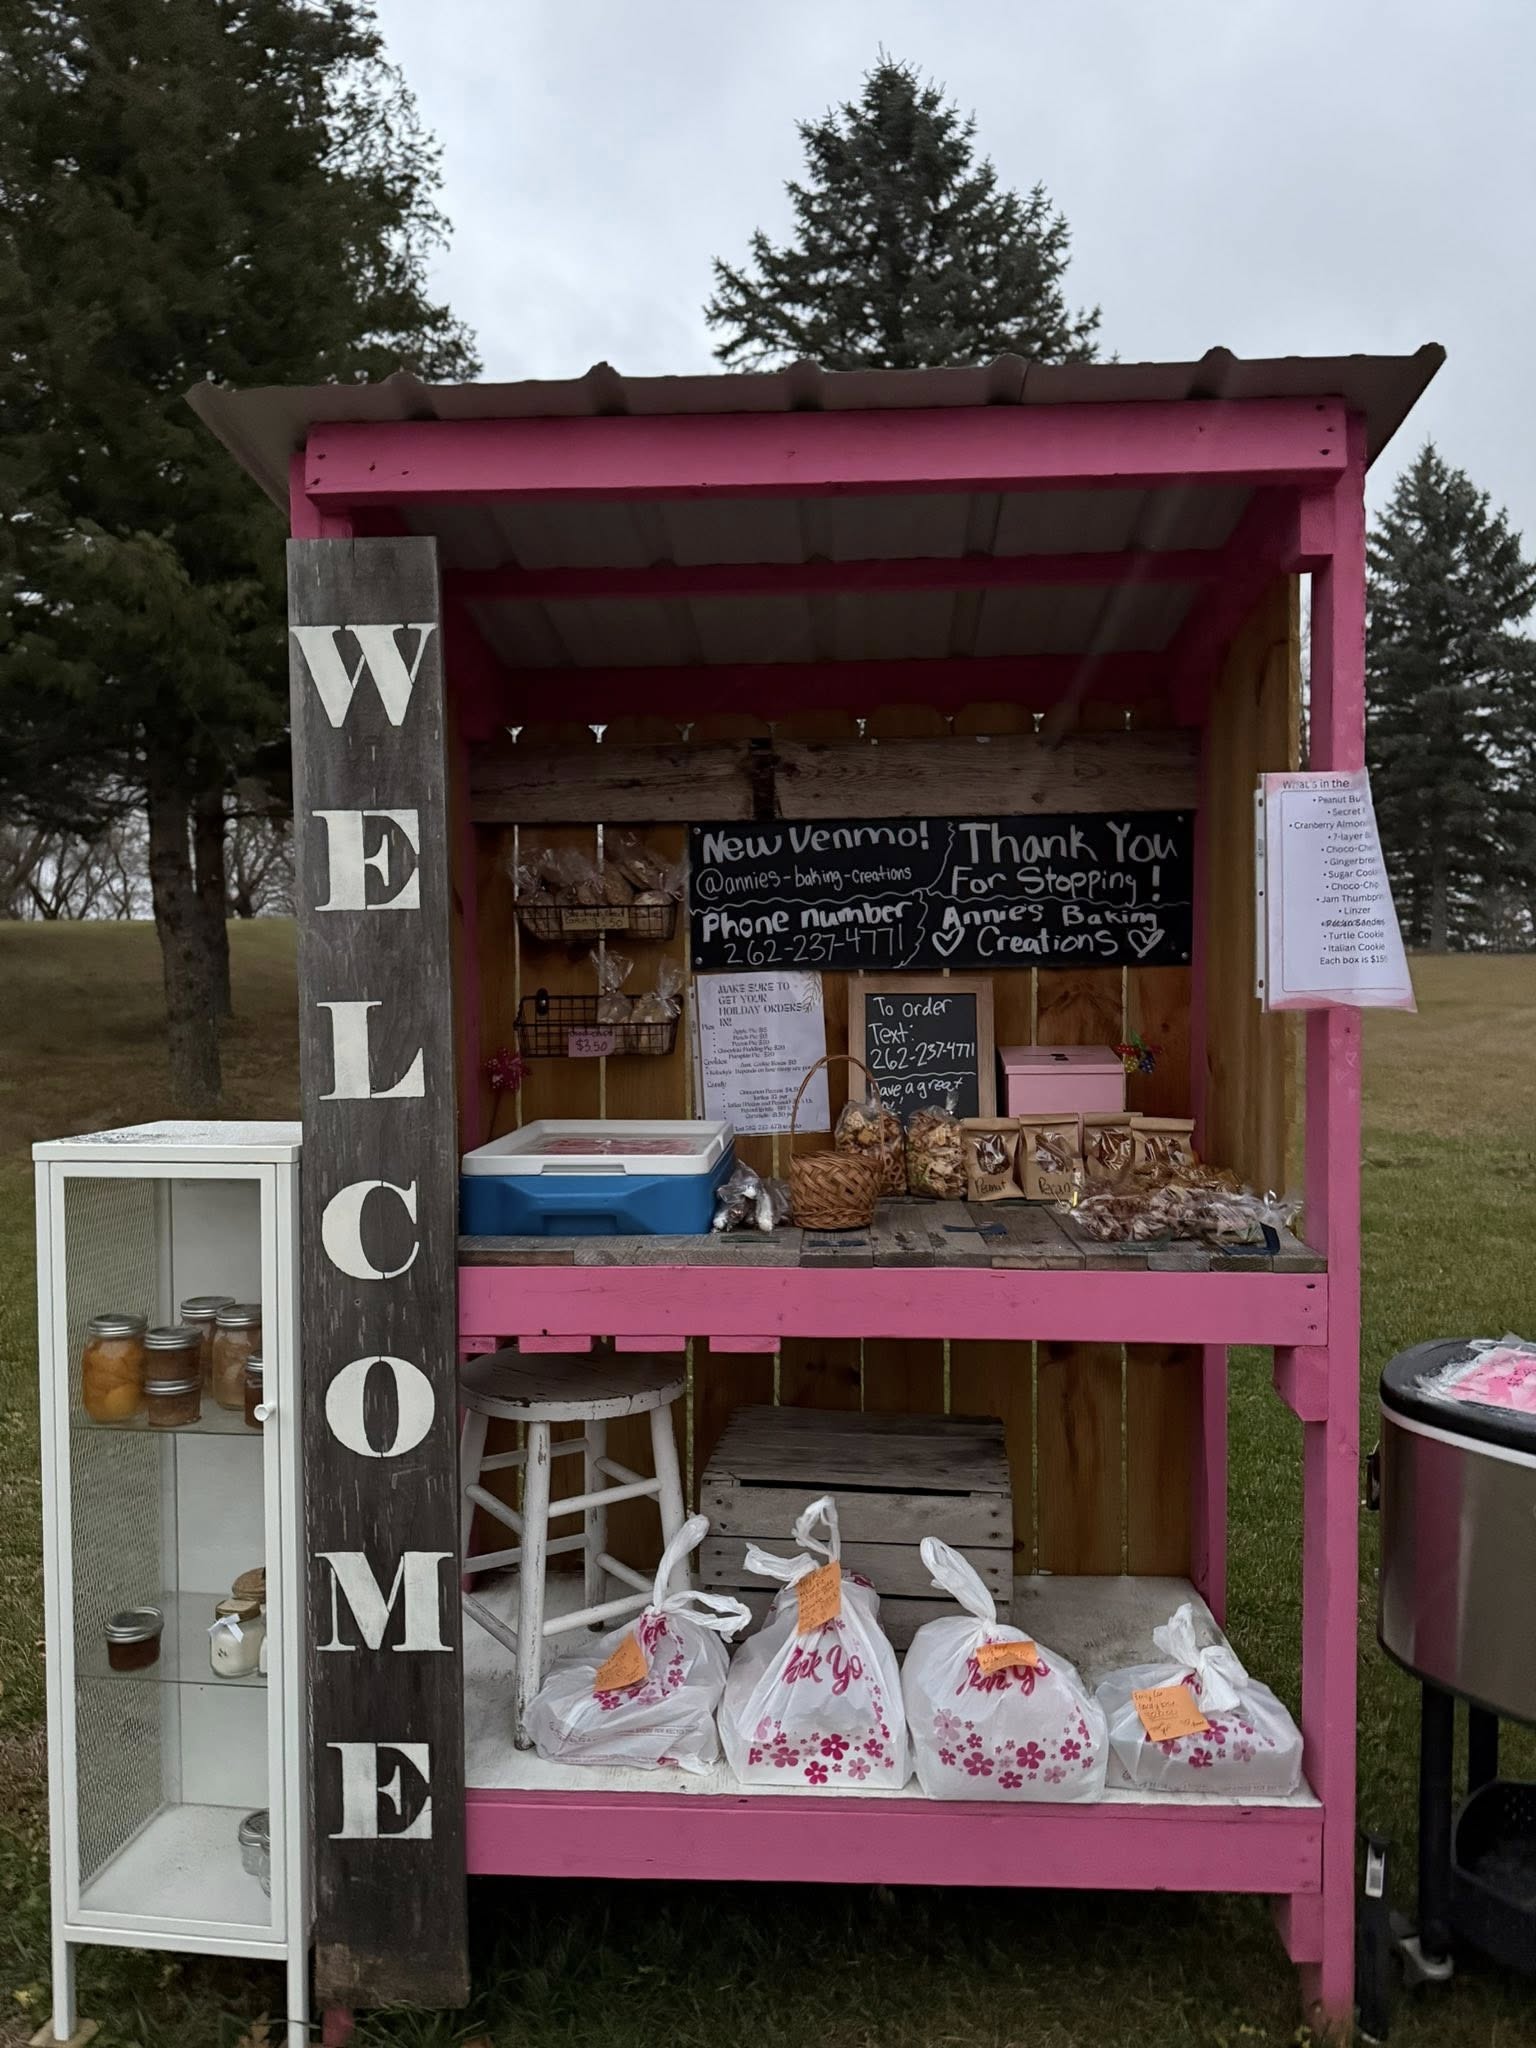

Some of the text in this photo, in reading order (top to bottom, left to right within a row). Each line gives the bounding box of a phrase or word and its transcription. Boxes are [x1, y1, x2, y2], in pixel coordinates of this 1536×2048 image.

[1320, 779, 1329, 788] in
[1331, 779, 1350, 788] the
[1332, 808, 1361, 816] Secret
[1294, 821, 1334, 830] Cranberry
[702, 820, 929, 864] New Venmo!
[958, 820, 1178, 863] Thank You
[951, 865, 1007, 896] For
[1328, 870, 1353, 880] Sugar
[1320, 895, 1339, 903] Jam
[1062, 905, 1157, 931] Baking
[1344, 907, 1370, 915] Linzer
[702, 902, 912, 943] Phone number
[723, 923, 903, 965] 262-237-4771
[977, 925, 1119, 957] Creations
[1329, 931, 1355, 940] Turtle
[1328, 944, 1356, 952] Italian
[1320, 956, 1340, 965] Each
[1342, 956, 1359, 964] box
[776, 982, 790, 990] TO
[872, 997, 894, 1016] To
[868, 1021, 914, 1046] Text:
[870, 1041, 975, 1070] 262-237-4771
[905, 1082, 914, 1094] a
[917, 1077, 963, 1099] great
[290, 622, 454, 1842] WELCOME
